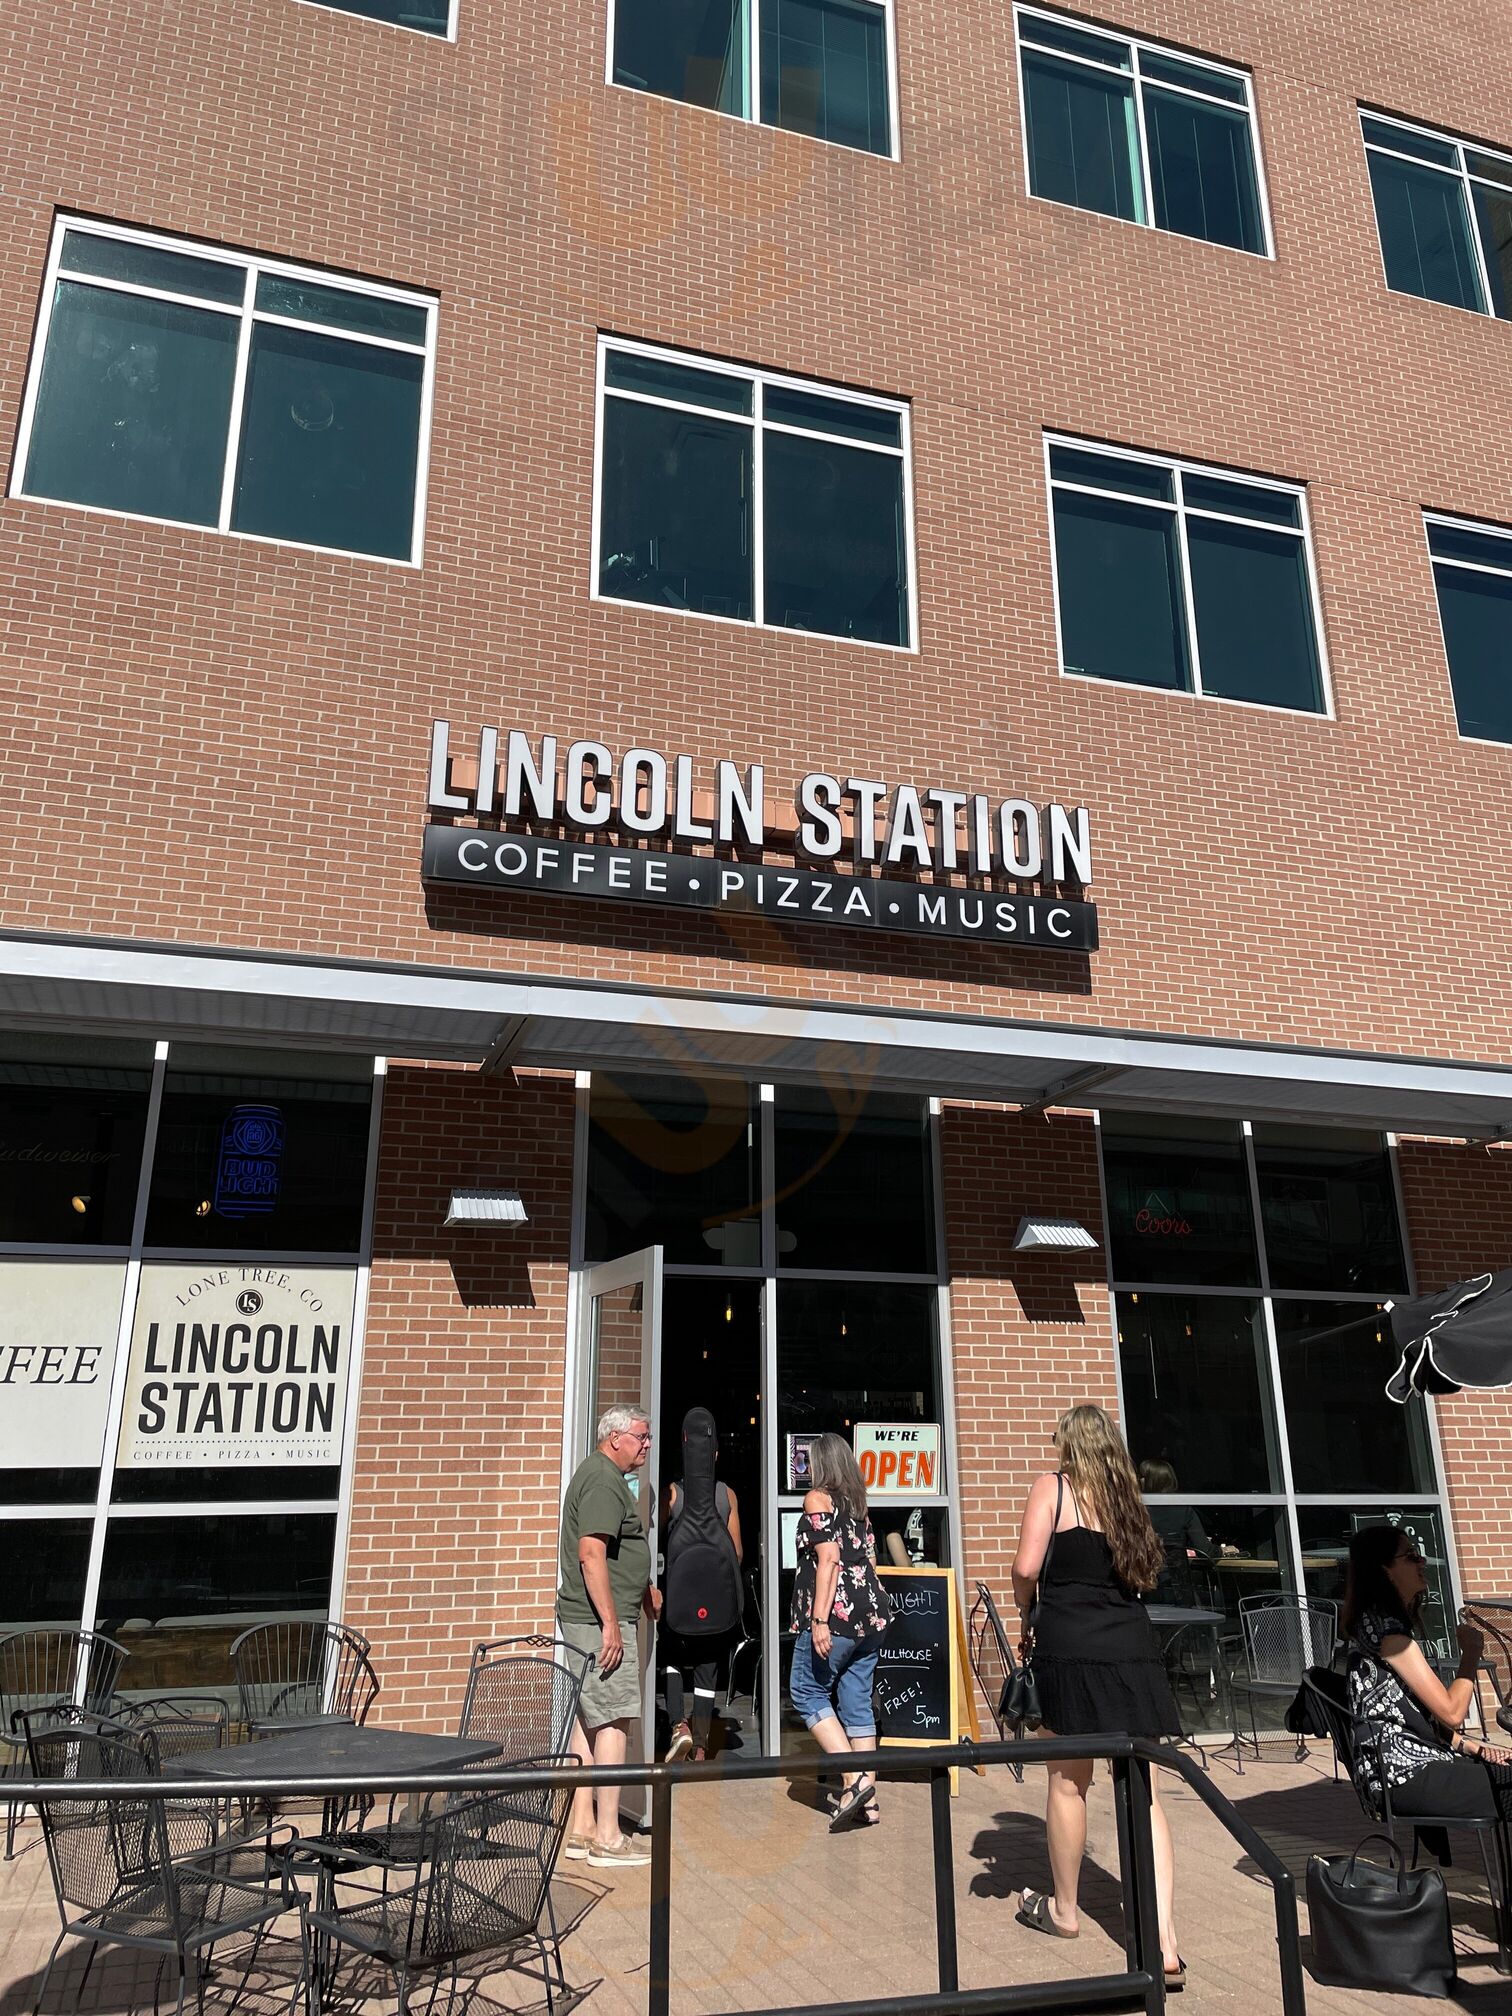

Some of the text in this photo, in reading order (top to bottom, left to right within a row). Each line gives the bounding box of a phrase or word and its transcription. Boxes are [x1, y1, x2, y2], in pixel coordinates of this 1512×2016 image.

[427, 719, 1094, 887] LINCOLN STATION
[458, 838, 1074, 939] COFFEE PIZZA MUSIC
[219, 1175, 279, 1195] LIGHT
[224, 1158, 277, 1178] BUD
[1136, 1208, 1193, 1234] Coors
[176, 1267, 324, 1313] LONE TREE, CO
[0, 1346, 103, 1384] FEE
[144, 1323, 341, 1375] LINCOLN
[138, 1382, 336, 1435] STATION
[875, 1430, 919, 1442] WE'RE
[133, 1449, 332, 1461] COFFEE PIZZA MUSIC
[859, 1449, 936, 1488] OPEN
[890, 1590, 939, 1609] NIGHT
[884, 1681, 923, 1715] FREE!
[912, 1704, 940, 1728] 5pm
